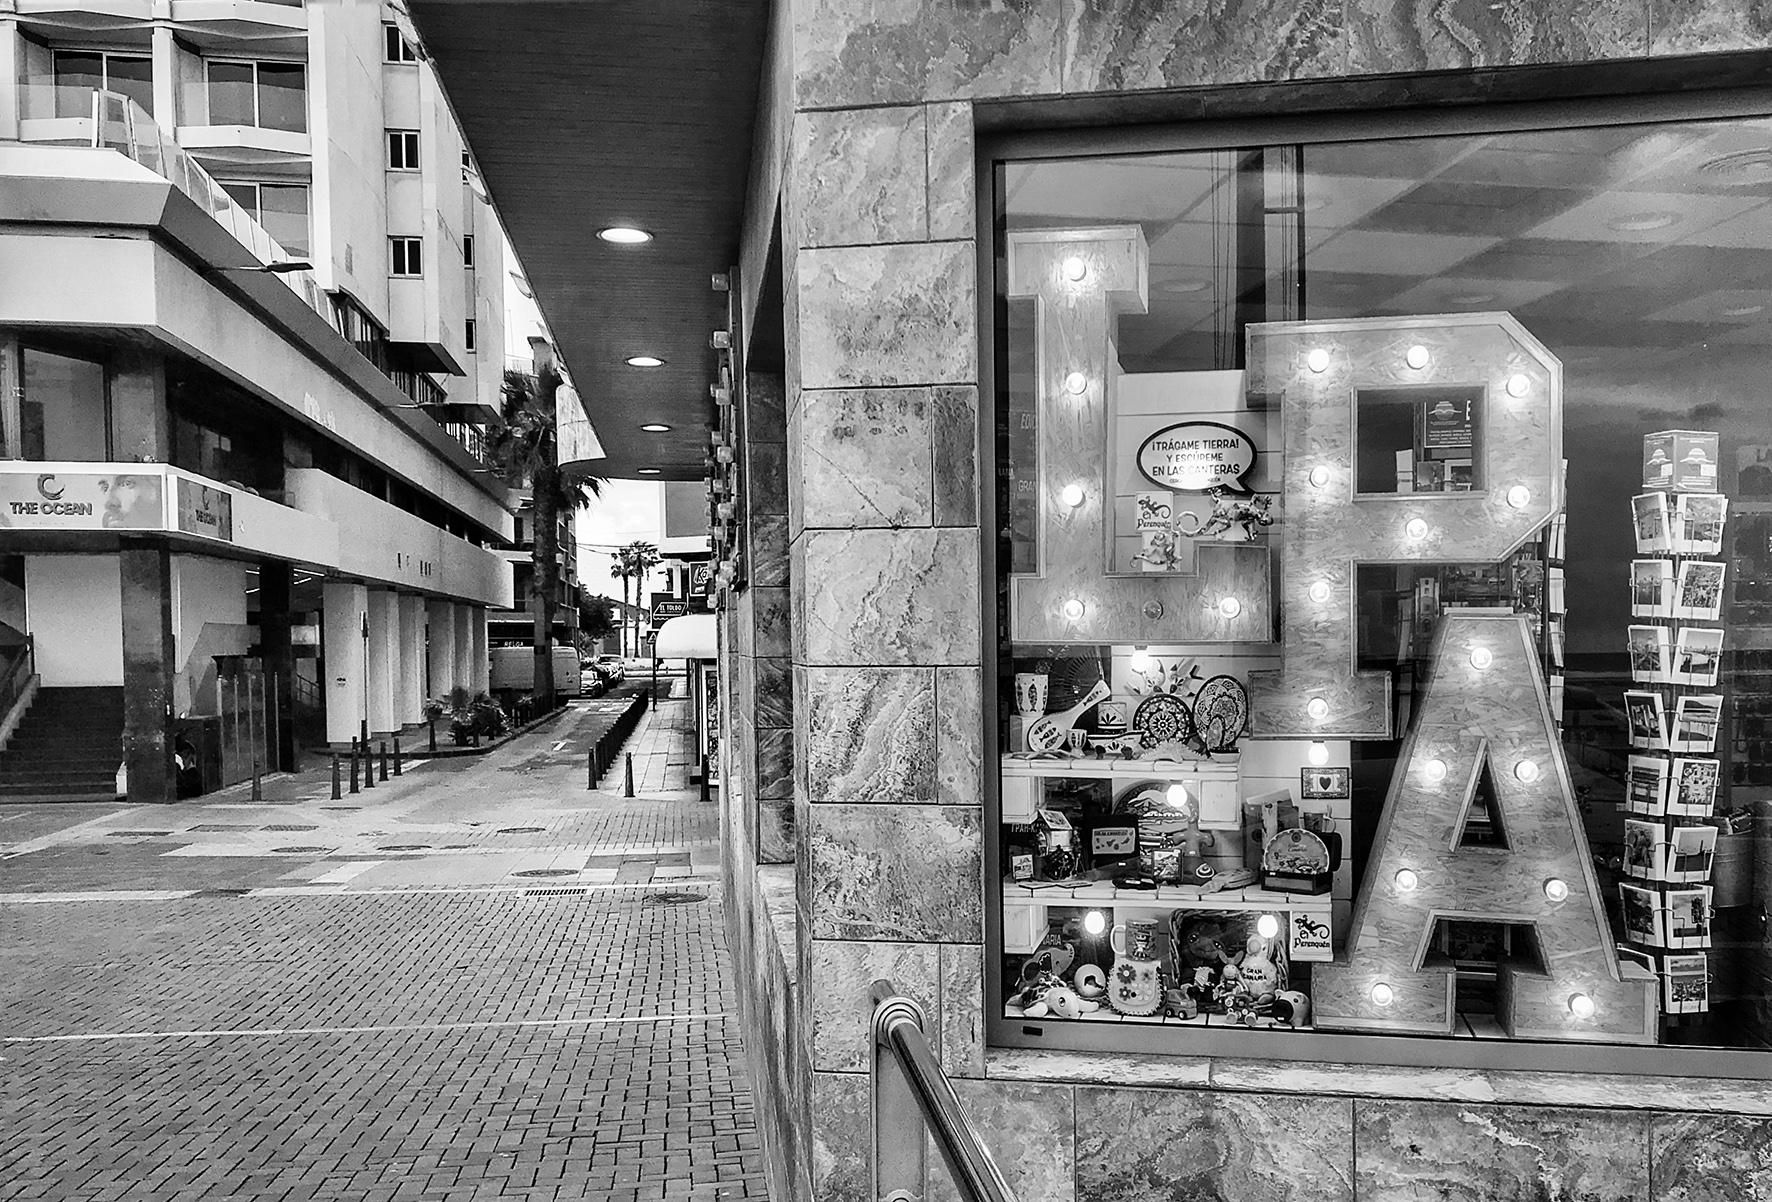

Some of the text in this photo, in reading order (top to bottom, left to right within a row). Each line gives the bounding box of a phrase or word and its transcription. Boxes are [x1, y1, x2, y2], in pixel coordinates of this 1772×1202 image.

[1202, 438, 1239, 449] TIERRA!
[1166, 454, 1173, 462] Y
[1152, 465, 1165, 476] EN
[1167, 465, 1184, 476] LAS
[9, 501, 92, 516] THE OCEAN
